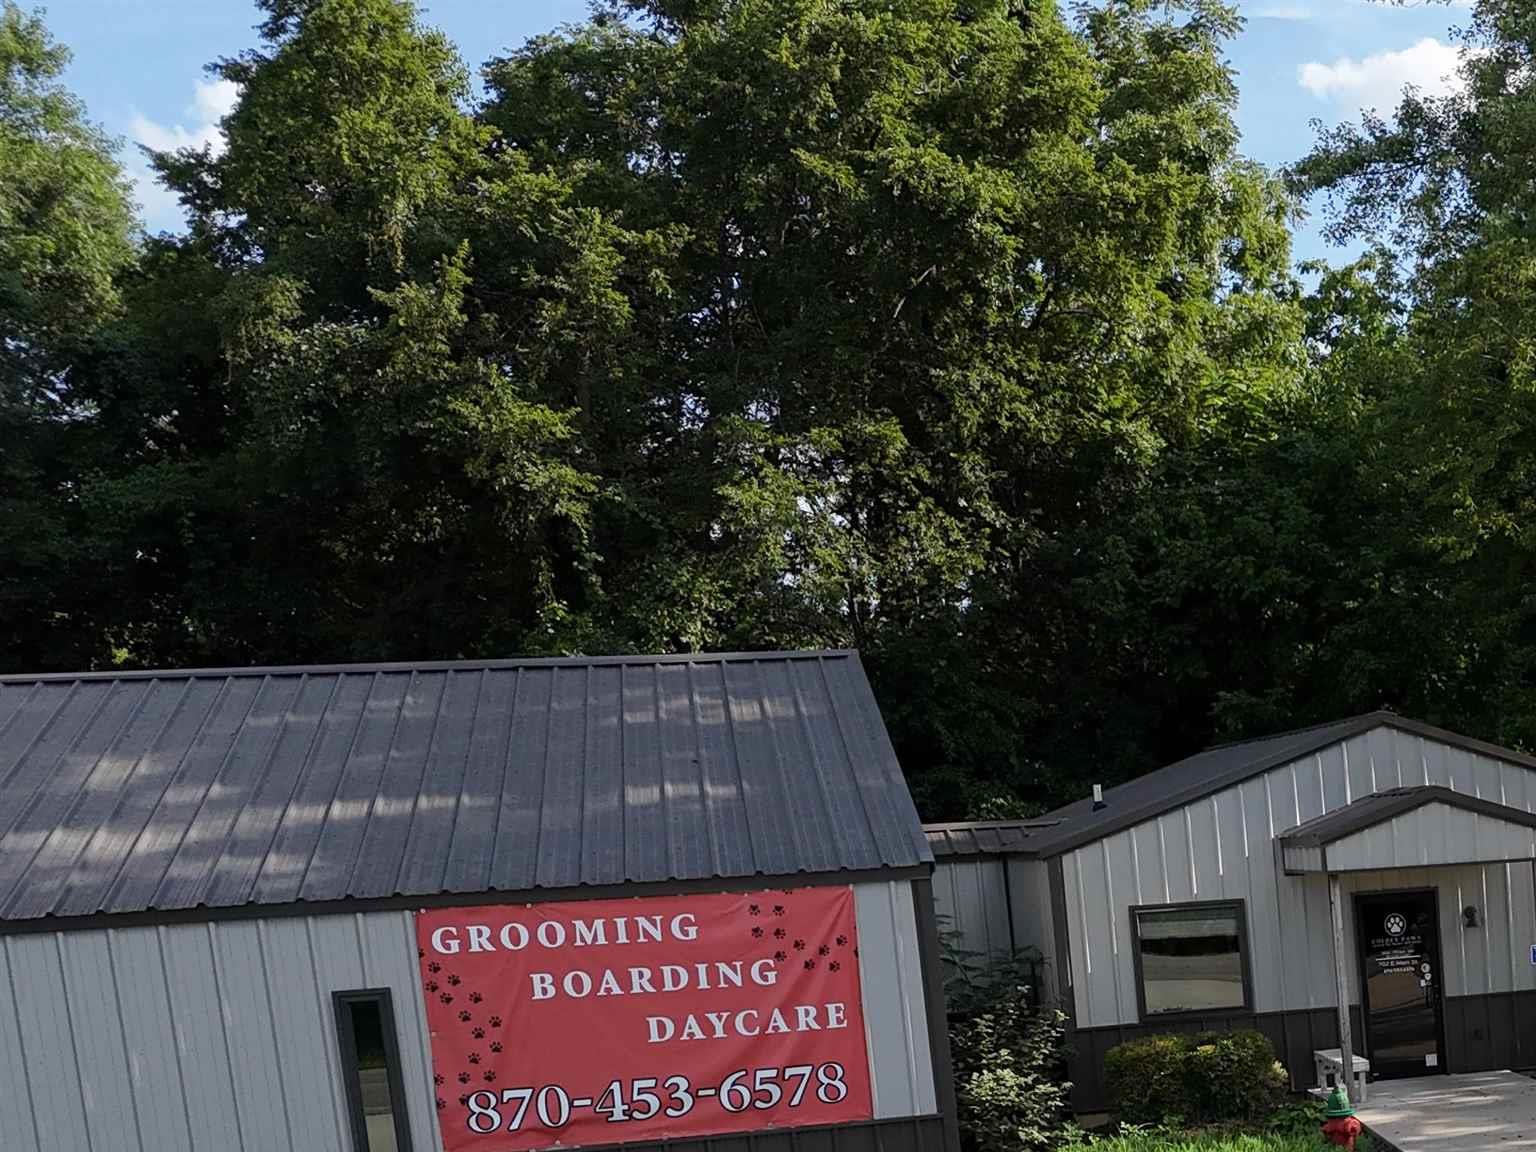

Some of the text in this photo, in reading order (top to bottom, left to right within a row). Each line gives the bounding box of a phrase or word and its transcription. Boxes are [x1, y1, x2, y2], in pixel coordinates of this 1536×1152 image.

[431, 913, 699, 954] GROOMING
[530, 959, 778, 1000] BOARDING
[646, 1003, 848, 1043] DAYCARE
[466, 1063, 847, 1133] 870-453-6578
